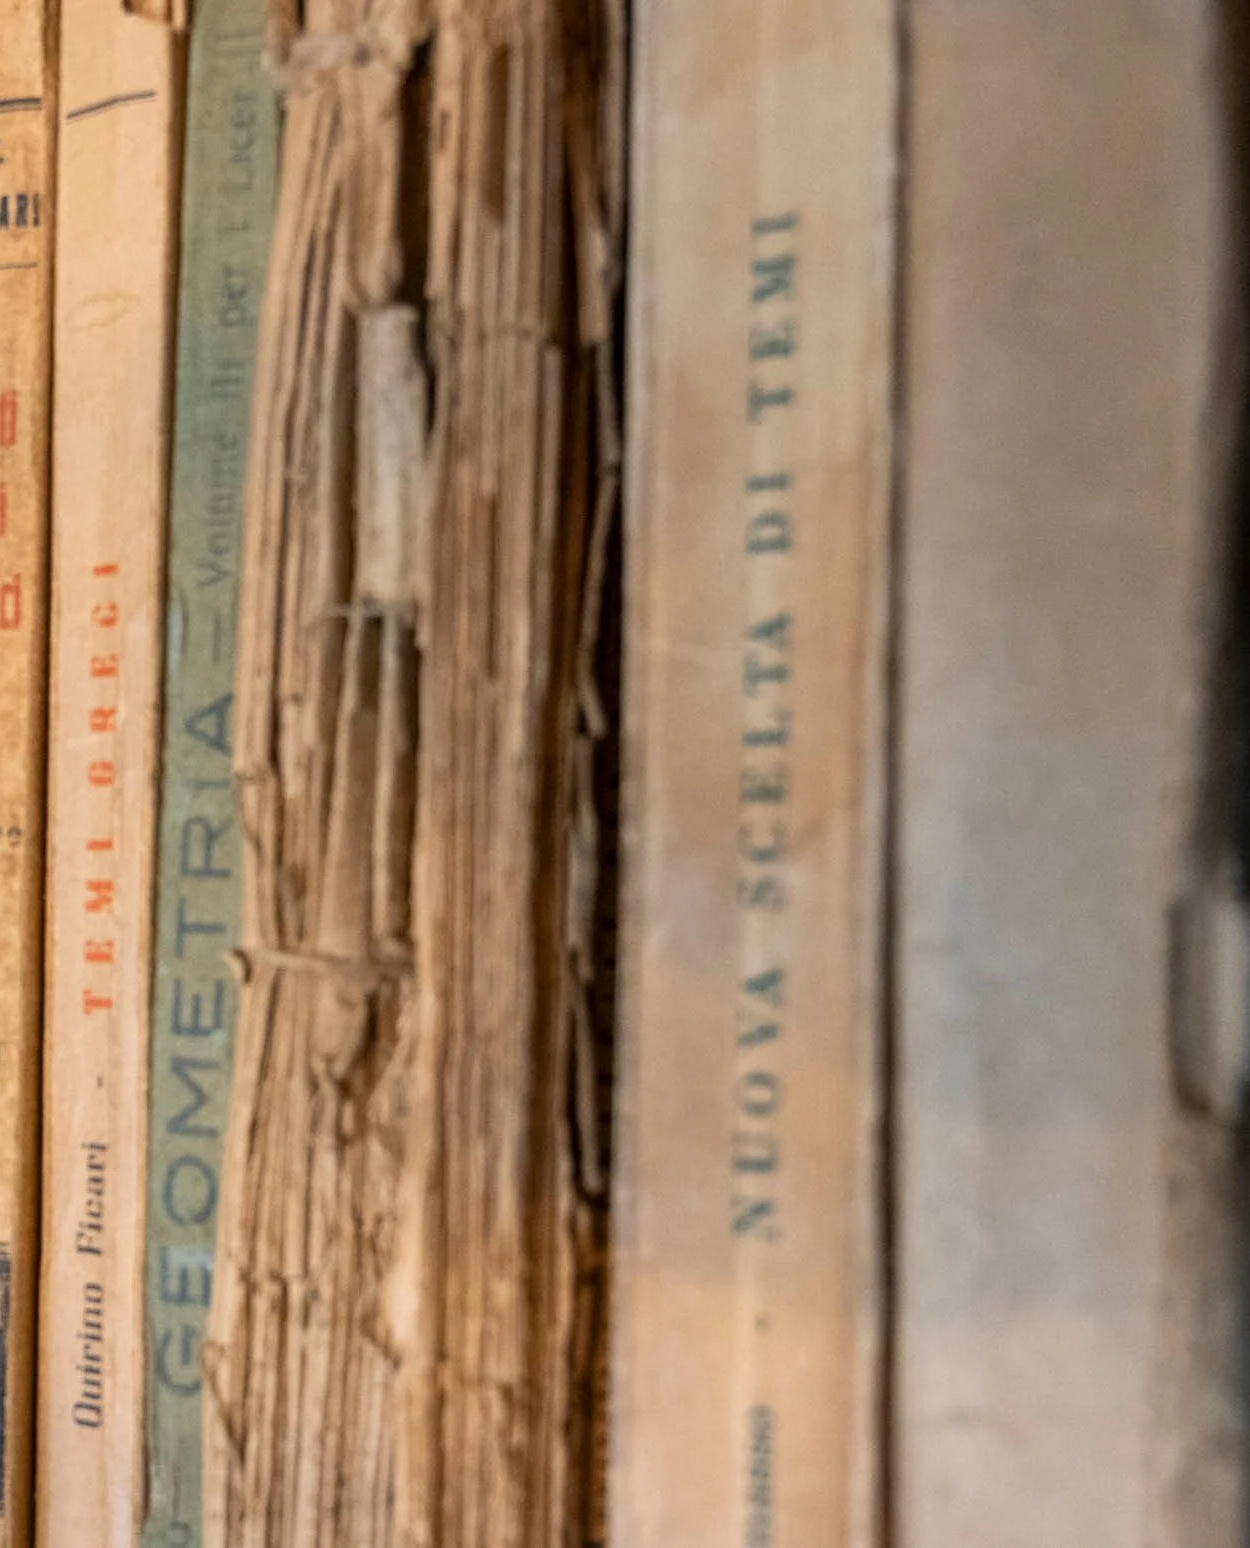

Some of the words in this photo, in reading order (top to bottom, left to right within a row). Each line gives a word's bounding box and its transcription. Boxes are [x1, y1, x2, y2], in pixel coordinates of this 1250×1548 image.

[746, 210, 800, 425] TEMI
[742, 469, 794, 557] DI
[86, 561, 119, 789] GRECI
[734, 609, 794, 916] SCELTA
[83, 836, 115, 1016] TEMI
[154, 692, 235, 1396] GEOMETRIA
[728, 964, 785, 1242] NUOVA
[75, 1142, 109, 1257] Ficari
[71, 1282, 104, 1430] Quirino
